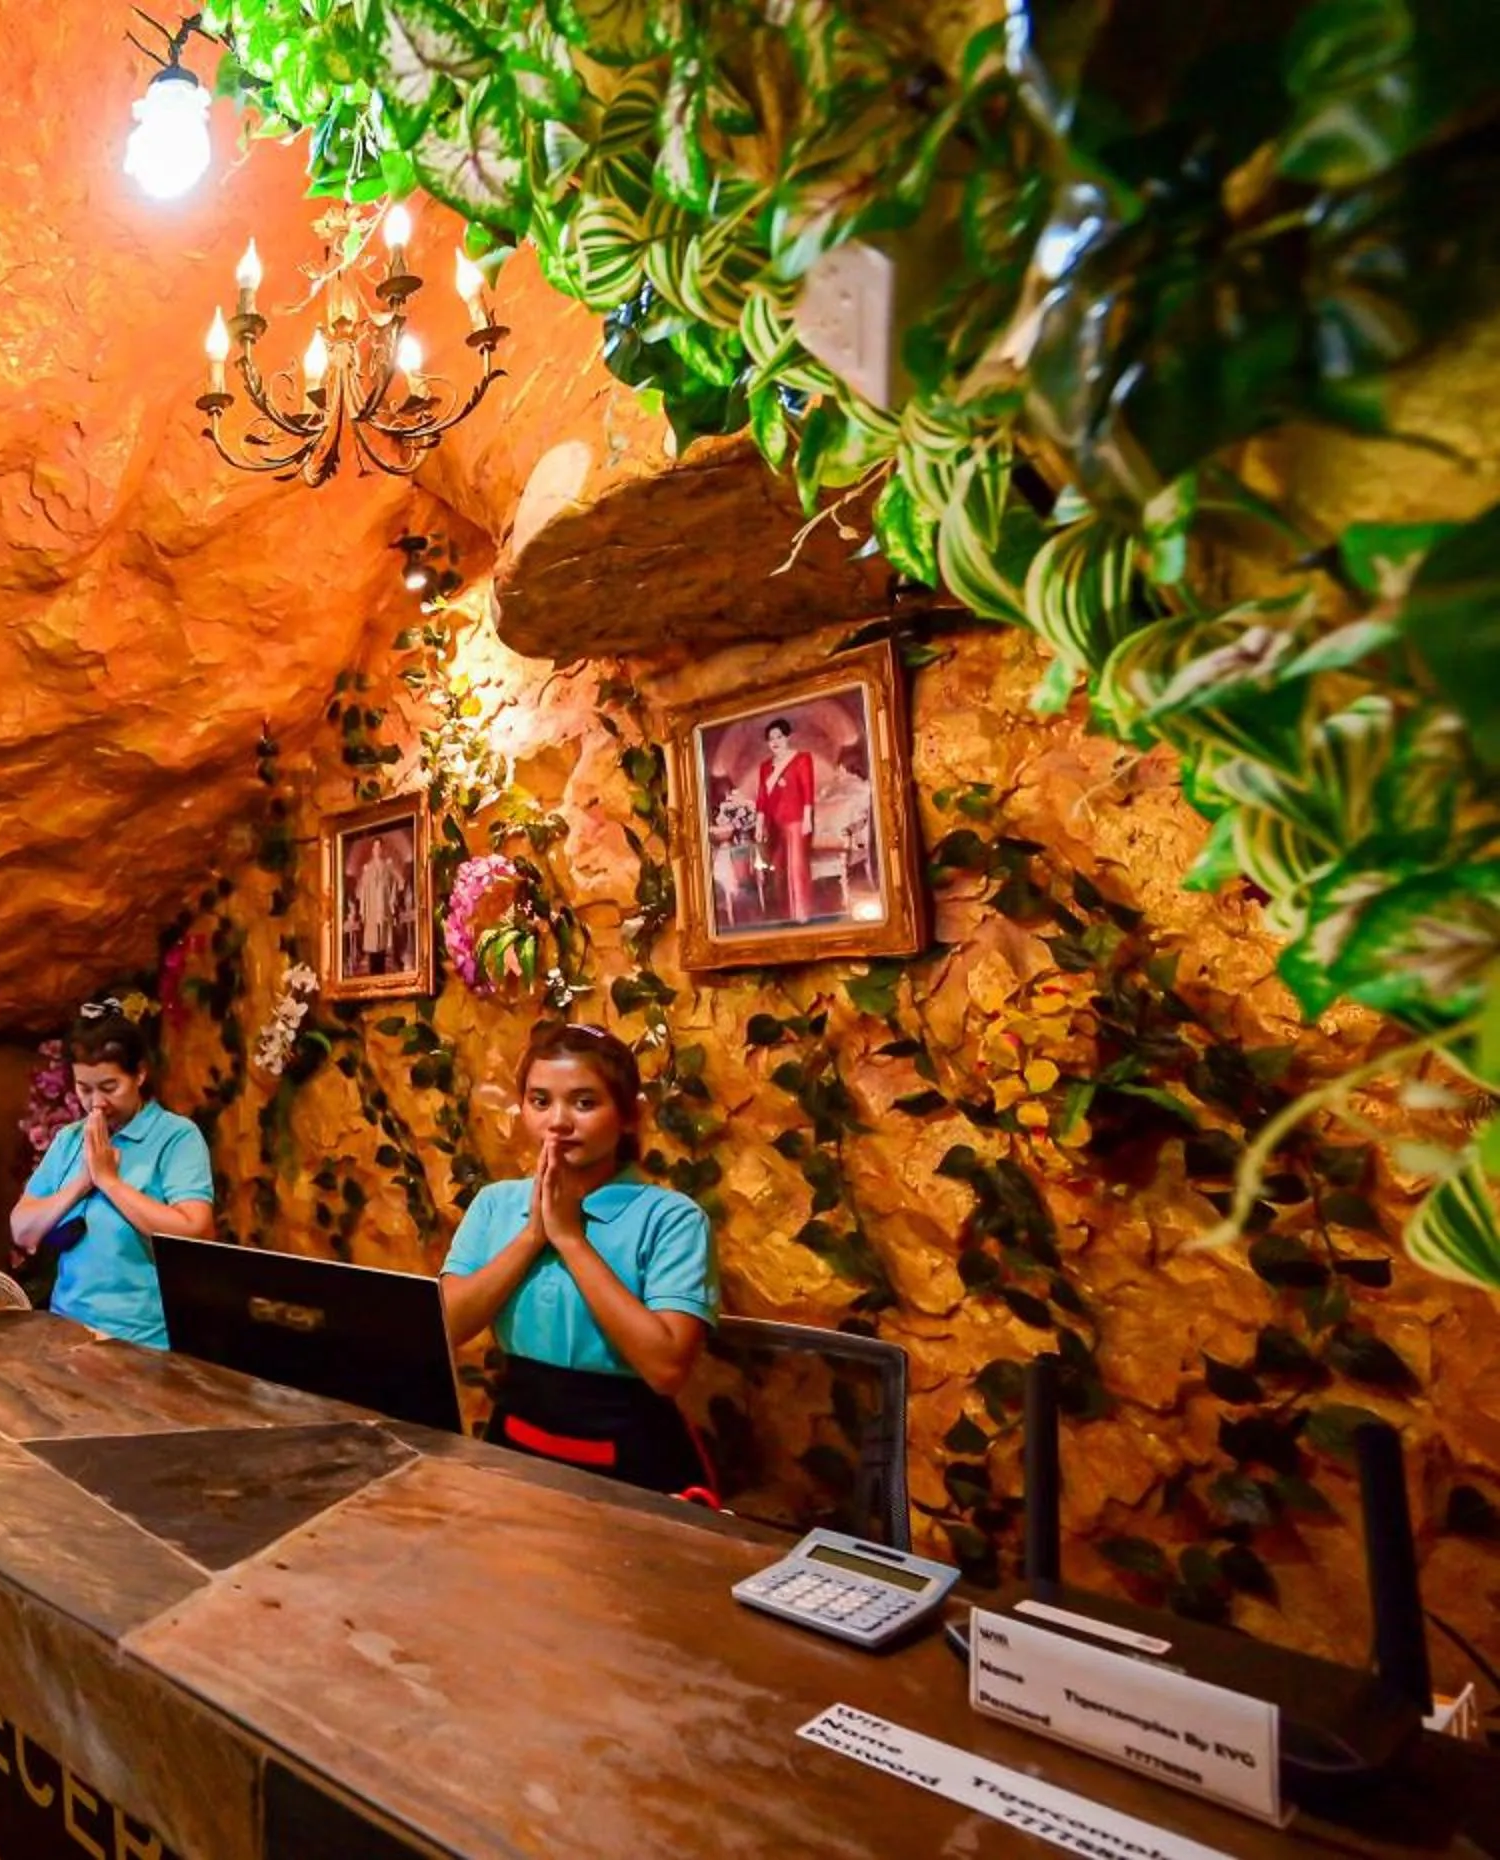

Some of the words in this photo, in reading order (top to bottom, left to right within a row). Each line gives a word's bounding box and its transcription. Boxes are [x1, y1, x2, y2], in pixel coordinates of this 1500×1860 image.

[248, 1296, 326, 1332] acer
[979, 1659, 1025, 1684] Name
[820, 1717, 904, 1755] Name
[1184, 1731, 1209, 1752] By
[805, 1726, 942, 1788] Password
